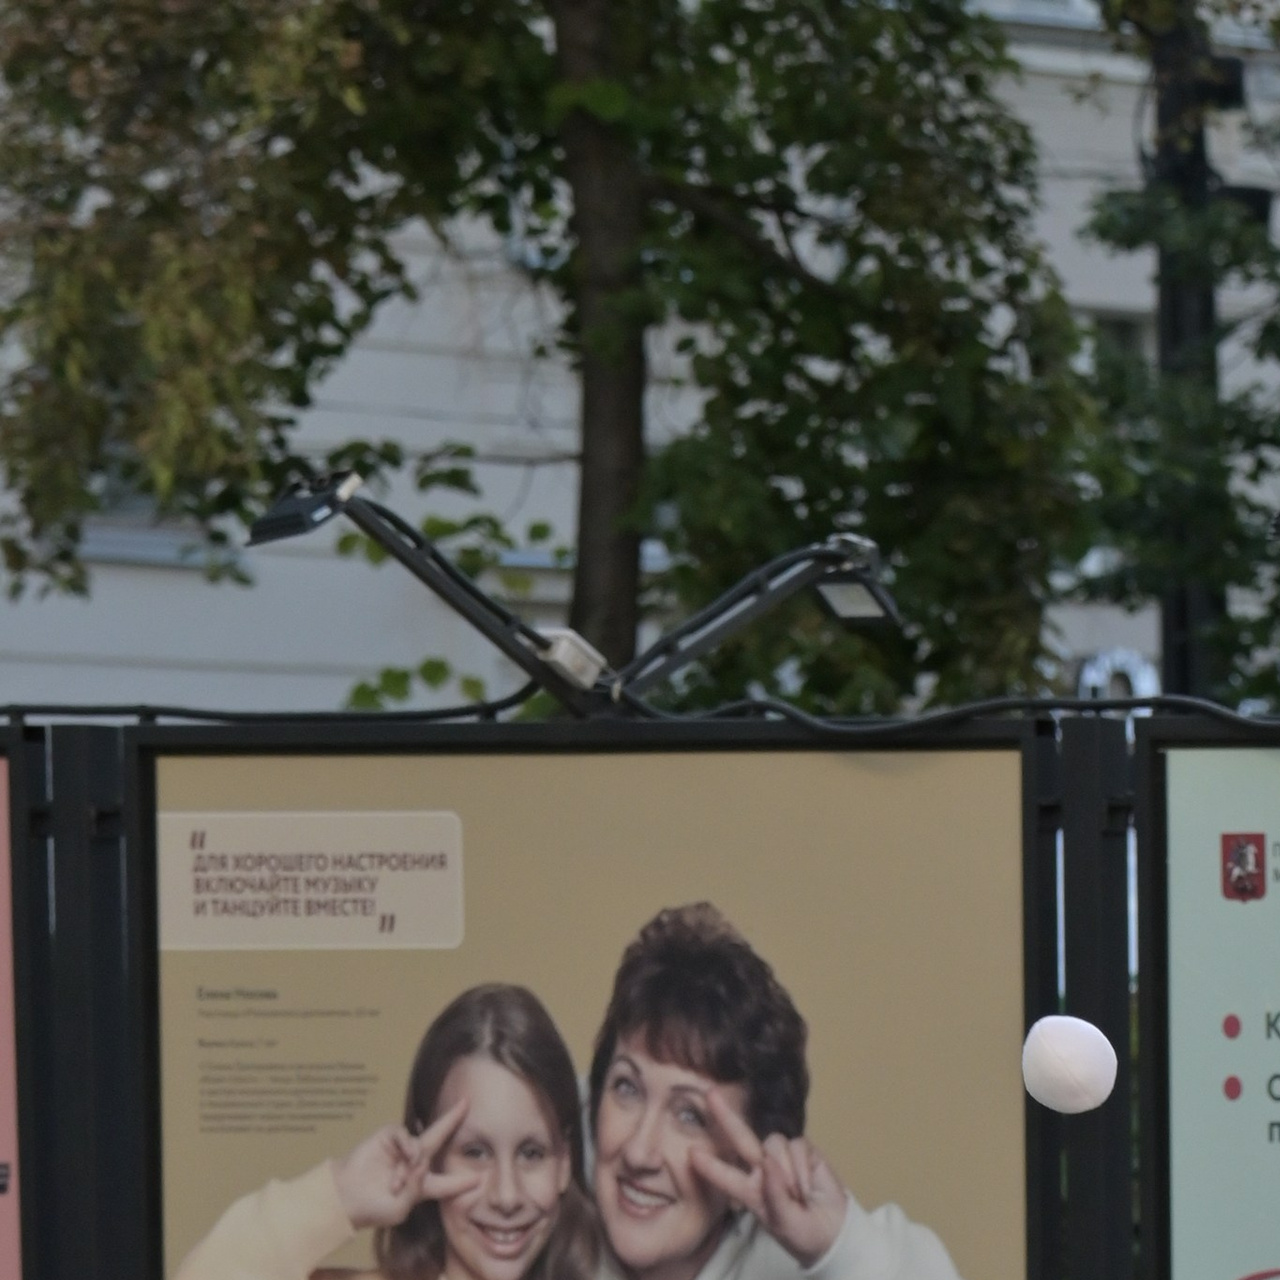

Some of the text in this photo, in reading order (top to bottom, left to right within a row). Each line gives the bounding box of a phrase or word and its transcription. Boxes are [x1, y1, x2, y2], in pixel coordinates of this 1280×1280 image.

[194, 852, 447, 873] ДЛЯ ХОРОШЕГО НАСТРОЕНИЯ
[194, 875, 379, 894] ВКЛЮЧАЙТЕ МУЗЫКУ
[193, 900, 208, 917] И
[211, 898, 301, 919] ТАНЦУЙТЕ
